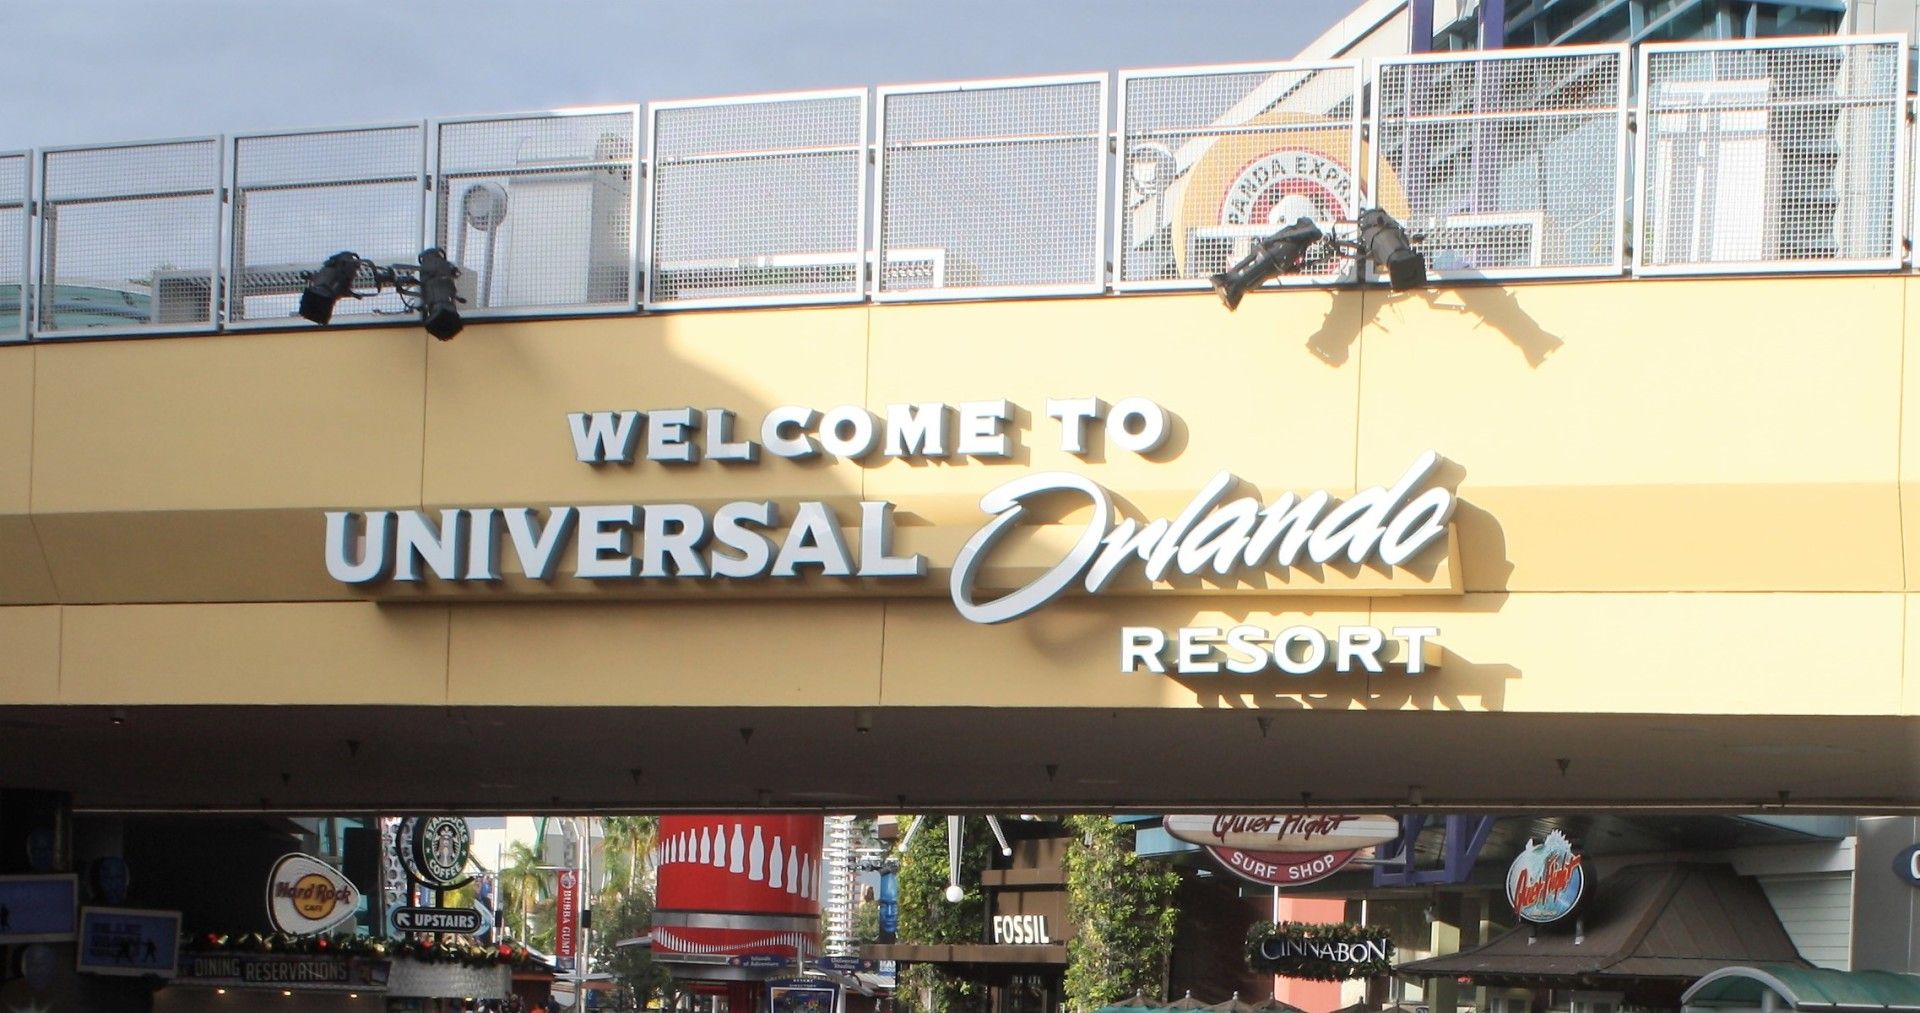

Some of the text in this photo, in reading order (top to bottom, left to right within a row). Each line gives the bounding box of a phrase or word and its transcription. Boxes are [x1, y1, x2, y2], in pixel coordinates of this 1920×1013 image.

[567, 396, 1170, 463] WELCOME TO
[324, 502, 928, 584] UNIVERSAL
[950, 449, 1457, 625] Orlando
[1121, 626, 1441, 676] RESORT
[429, 859, 463, 879] COFFEE
[1230, 851, 1335, 880] SURF SHOP
[276, 881, 352, 905] Hard Rock
[415, 913, 475, 928] UPSTAIRS
[561, 890, 572, 956] BUBBA GUMP
[993, 915, 1050, 944] FOSSIL
[1261, 938, 1387, 963] CINNABON
[194, 957, 348, 981] DINING RESERVATIONS
